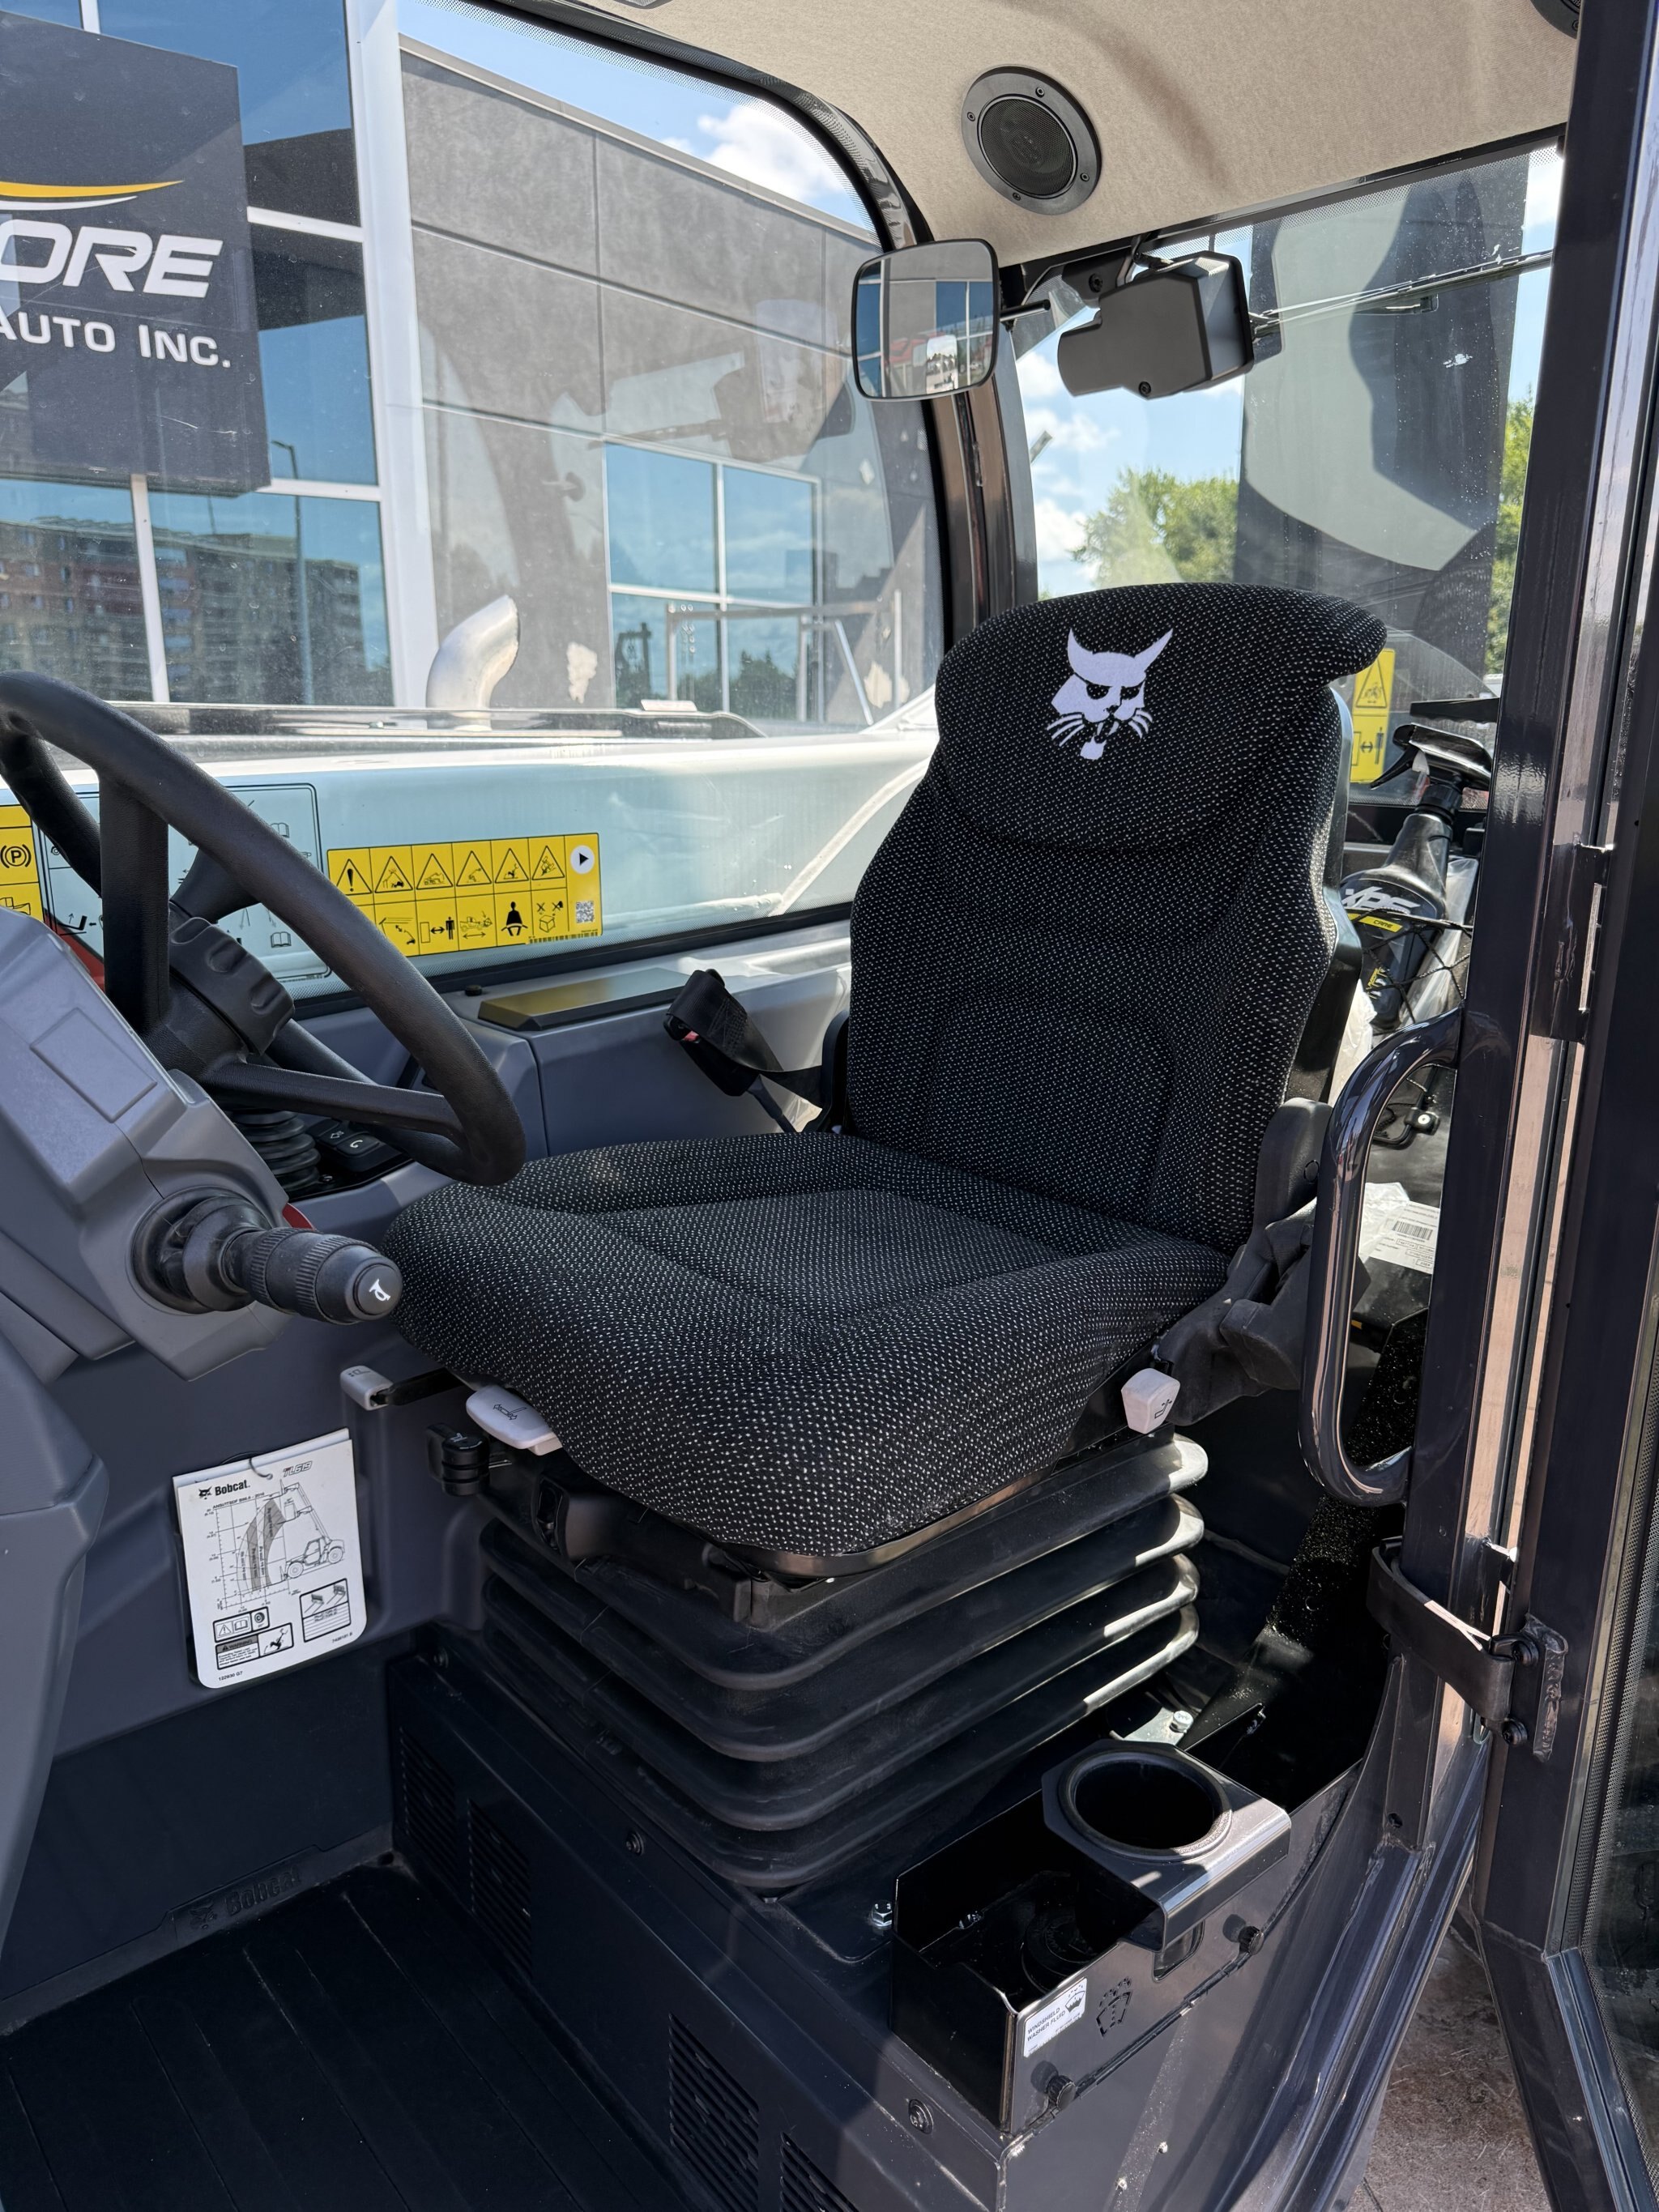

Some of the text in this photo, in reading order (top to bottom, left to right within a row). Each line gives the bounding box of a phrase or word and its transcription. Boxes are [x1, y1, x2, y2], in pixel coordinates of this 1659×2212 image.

[139, 324, 231, 368] INC.
[1027, 2007, 1060, 2034] WINDSHIELD
[1027, 2022, 1050, 2041] WASHER
[1050, 2010, 1066, 2025] FLUID
